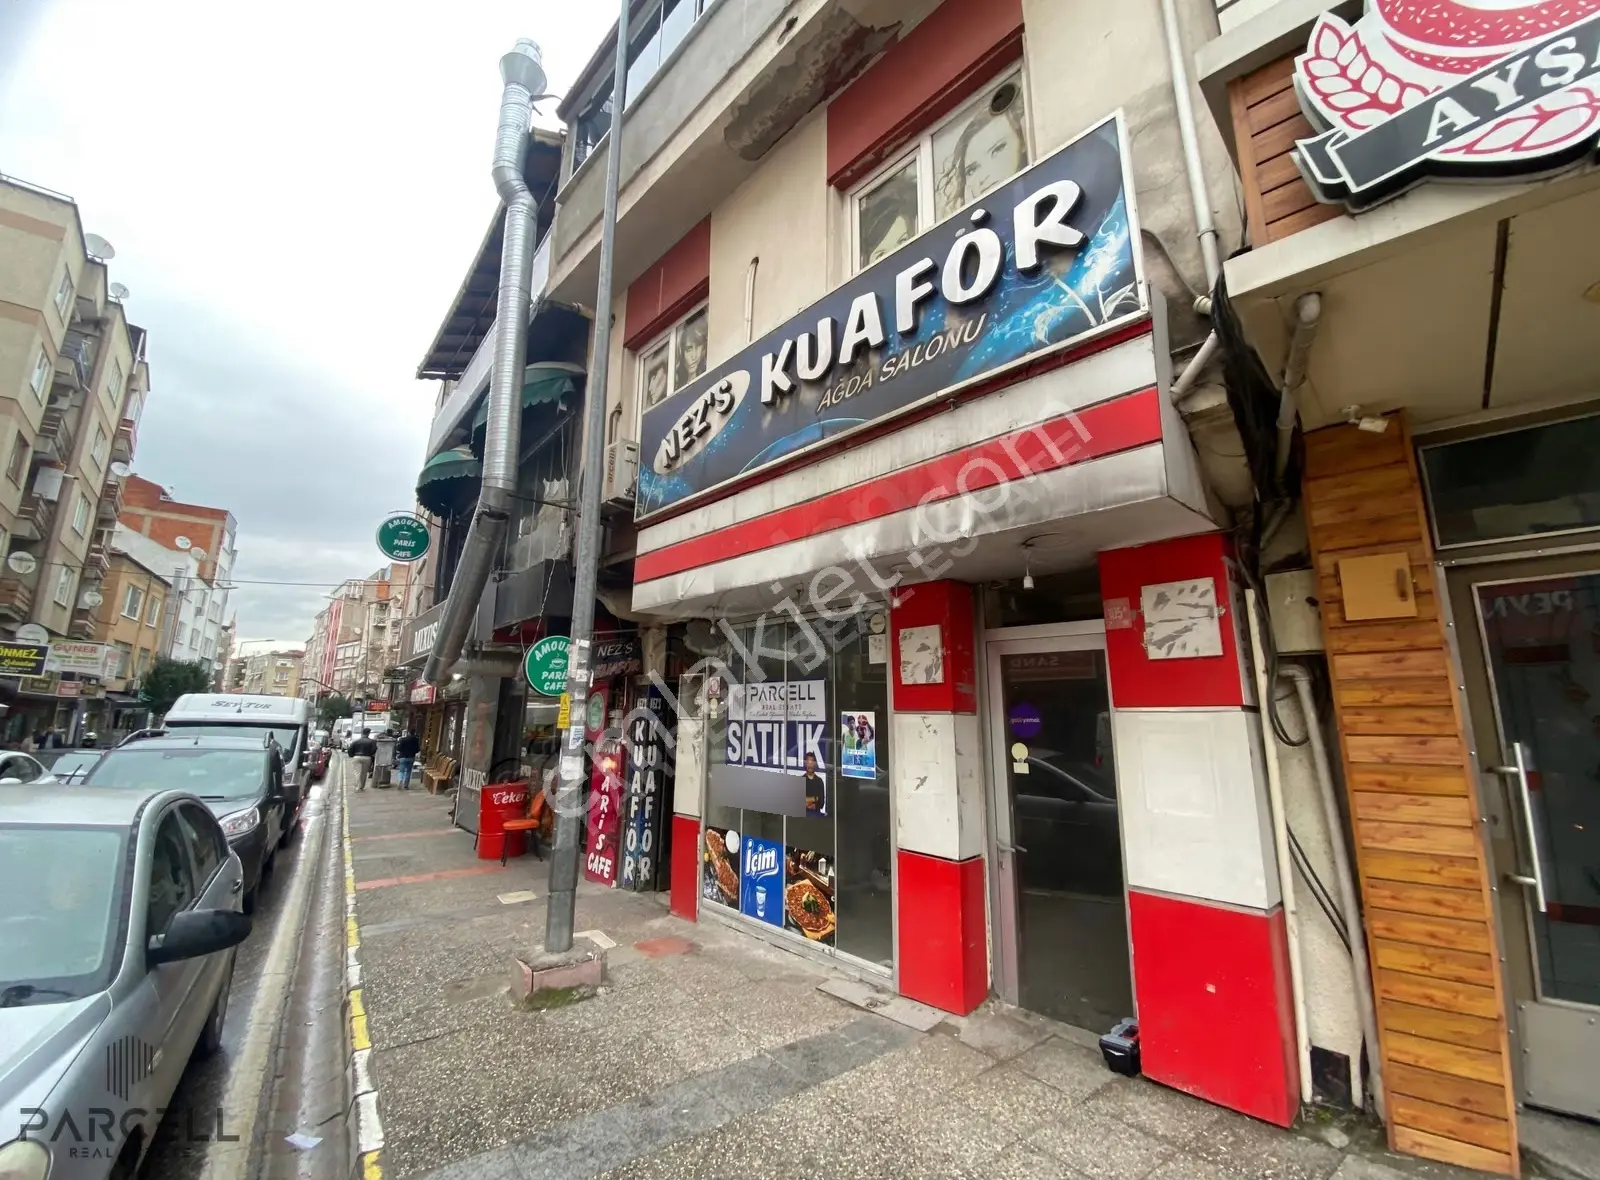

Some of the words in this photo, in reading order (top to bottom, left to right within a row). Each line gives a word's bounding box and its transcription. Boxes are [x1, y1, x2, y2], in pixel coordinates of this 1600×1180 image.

[1422, 36, 1600, 147] AYS
[661, 379, 736, 469] NEZ'S
[760, 179, 1087, 405] KUAFÖR
[817, 372, 874, 412] AĞDA
[879, 312, 988, 383] SALONU
[597, 642, 633, 657] NEZ'S
[750, 684, 816, 701] PARCELL
[727, 721, 826, 769] SATILIK
[623, 720, 645, 881] KUAFÖR
[639, 720, 658, 881] KUAFÖR
[587, 852, 612, 879] CAFE
